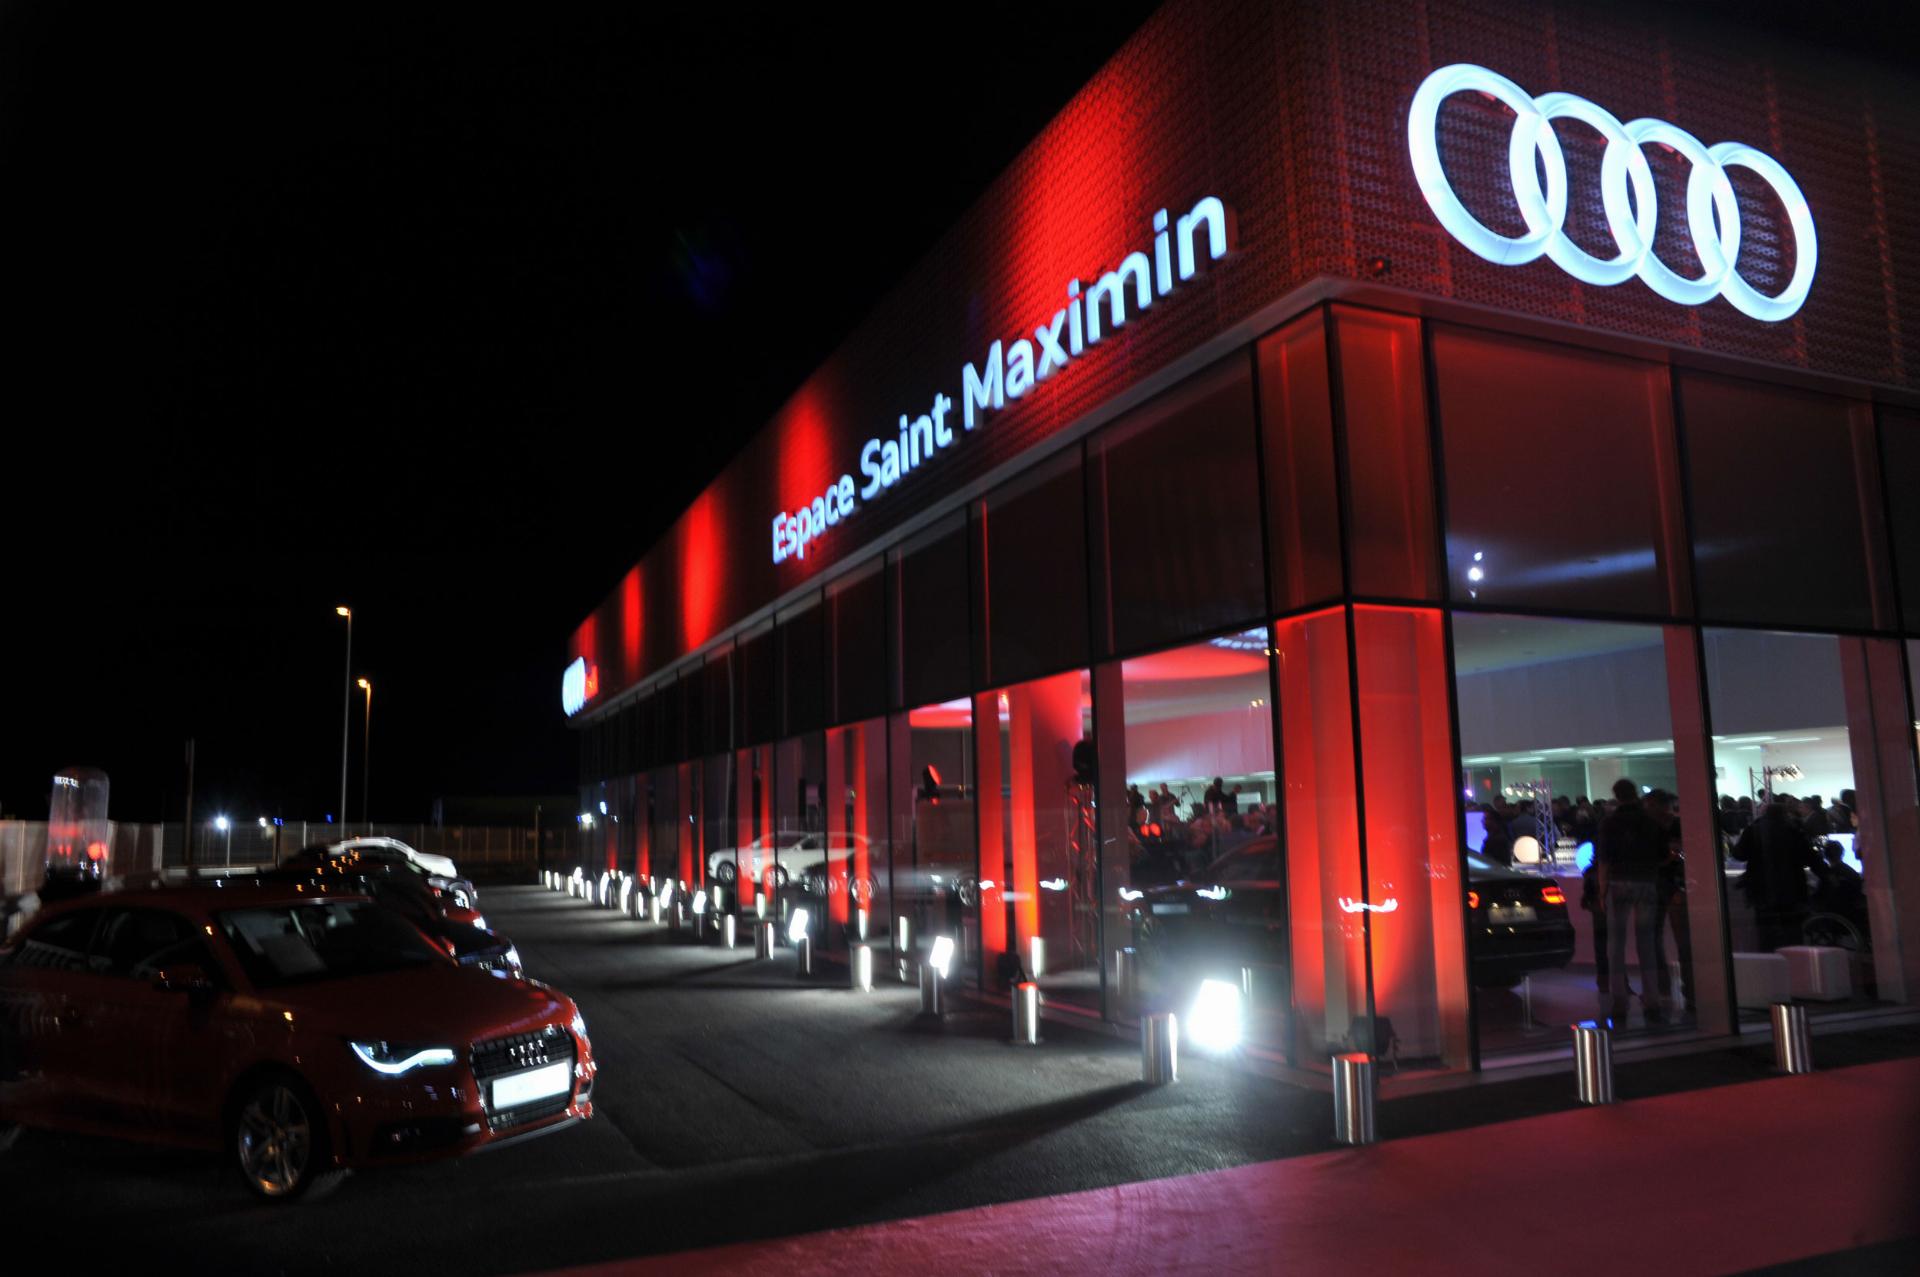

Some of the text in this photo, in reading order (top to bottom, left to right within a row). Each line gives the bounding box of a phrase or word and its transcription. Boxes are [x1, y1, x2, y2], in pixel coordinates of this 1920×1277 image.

[772, 196, 1227, 564] Espace Saint Maximin
